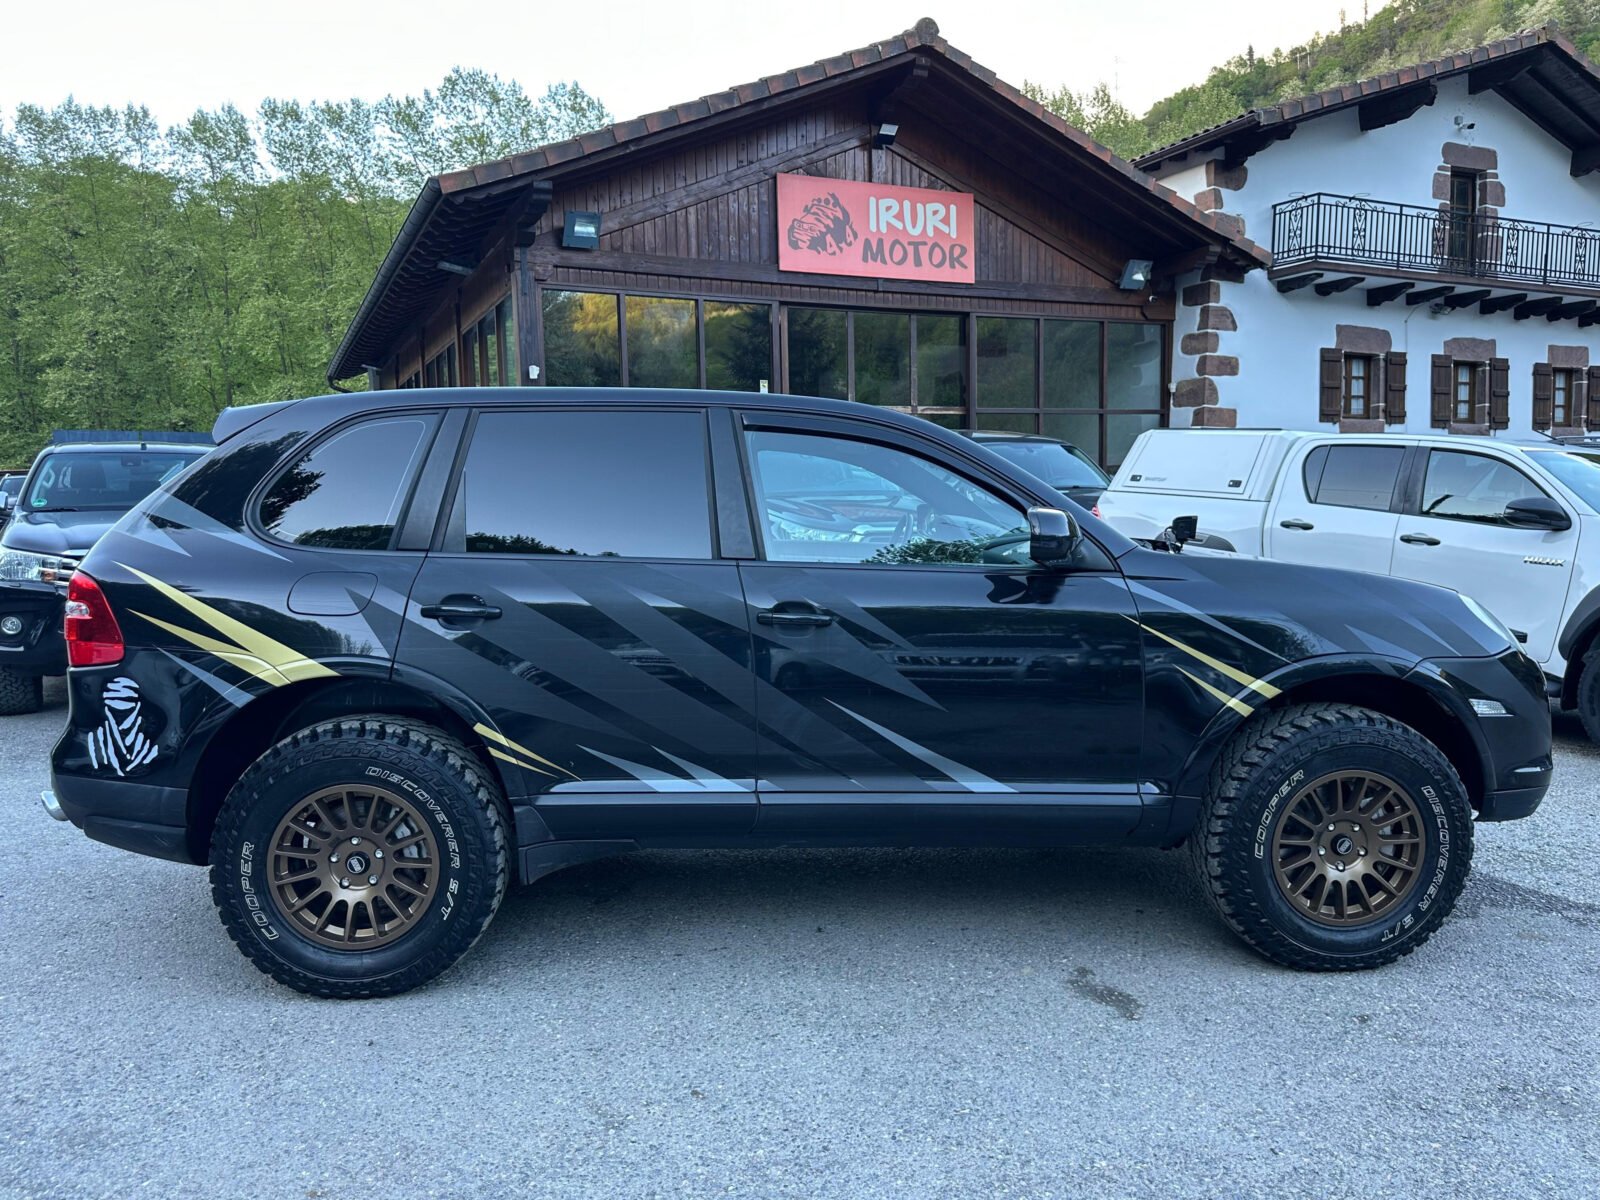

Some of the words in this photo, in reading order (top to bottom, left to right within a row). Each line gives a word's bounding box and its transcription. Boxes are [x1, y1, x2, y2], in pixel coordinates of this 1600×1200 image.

[869, 197, 957, 238] IRURI
[862, 238, 968, 269] MOTOR
[1523, 556, 1566, 567] HILUX
[365, 765, 460, 869] DISCOVERER
[440, 877, 459, 921] S/T
[1254, 769, 1305, 859] COOPER
[1417, 785, 1450, 912] DISCOVERER
[240, 841, 280, 940] COOPER
[1381, 913, 1415, 942] S/T
